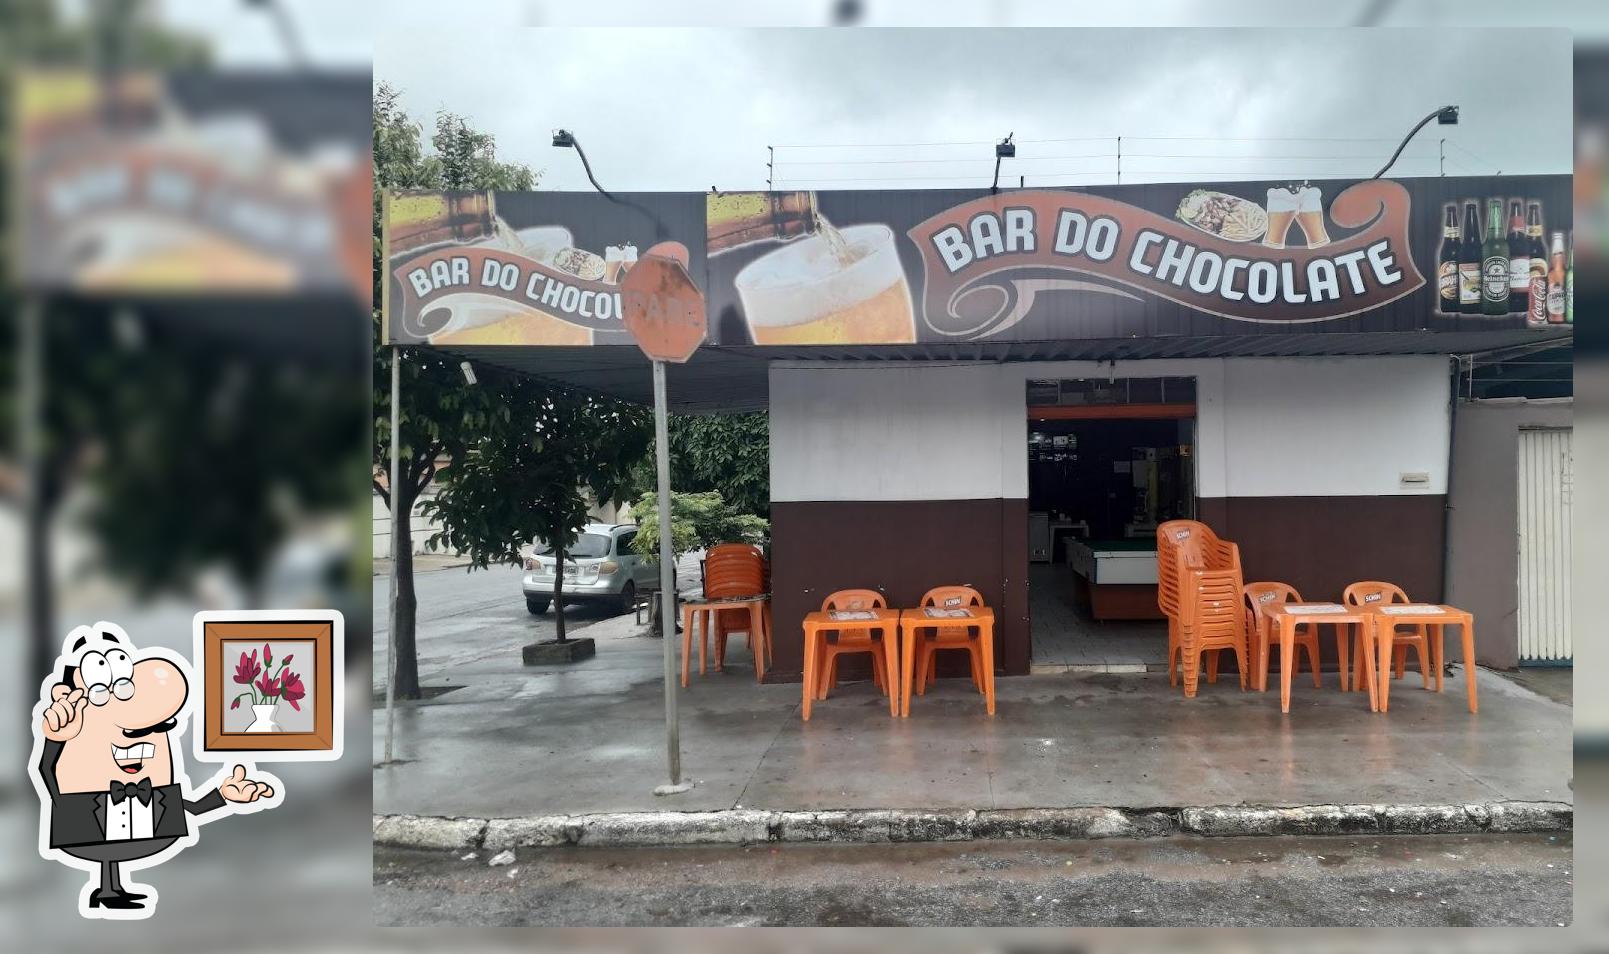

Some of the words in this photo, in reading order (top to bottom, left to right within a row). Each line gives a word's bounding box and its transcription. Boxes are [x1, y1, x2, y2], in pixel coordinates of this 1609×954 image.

[408, 257, 470, 297] BAR
[481, 260, 519, 291] DO
[932, 208, 1037, 274] BAR
[1054, 210, 1114, 262] DO
[1130, 232, 1401, 303] CHOCOLATE
